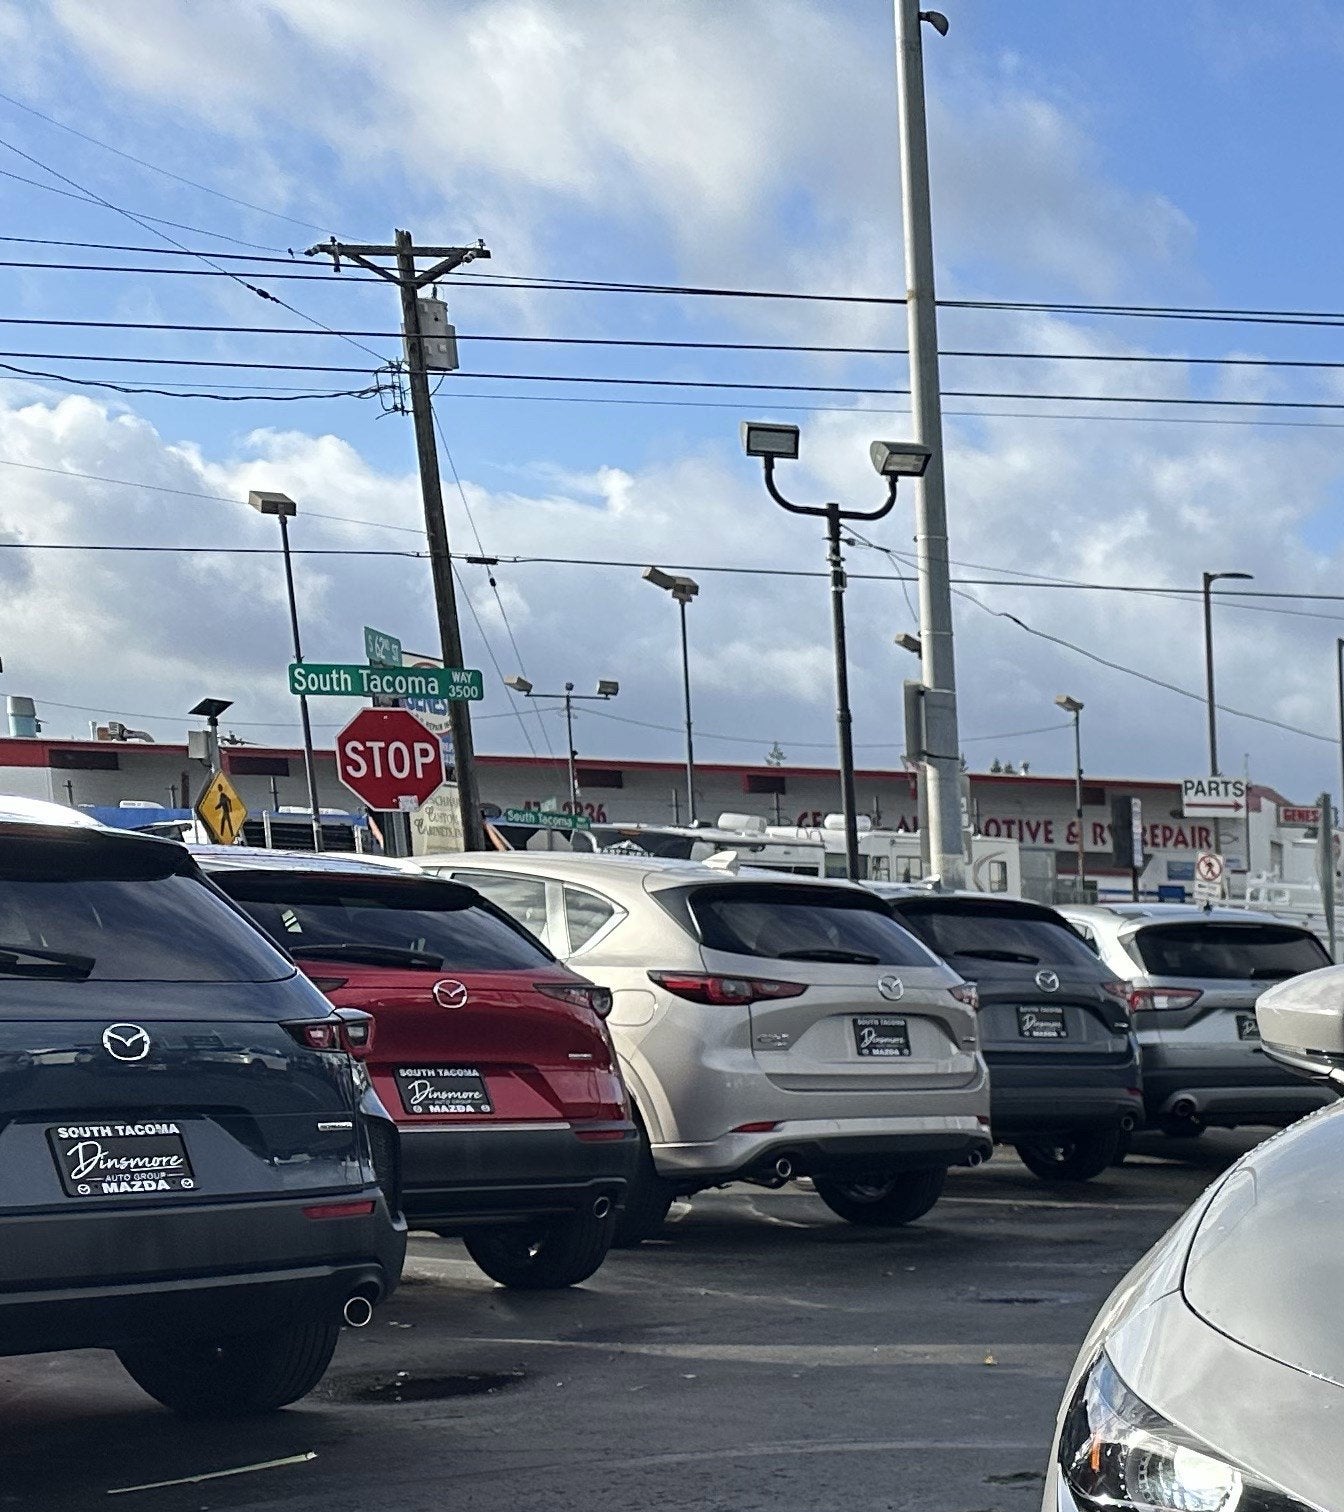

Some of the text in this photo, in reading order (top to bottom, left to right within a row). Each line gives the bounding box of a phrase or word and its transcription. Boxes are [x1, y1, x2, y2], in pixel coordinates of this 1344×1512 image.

[293, 667, 440, 696] South Tacoma
[451, 671, 473, 684] WAY
[448, 685, 479, 699] 3500
[344, 740, 436, 780] STOP
[1183, 779, 1245, 798] PARTS
[399, 1068, 480, 1077] SOUTH TACOMA
[407, 1079, 483, 1105] Dinsmore
[428, 1104, 475, 1113] MAZDA
[57, 1123, 180, 1139] SOUTH TACOMA
[66, 1140, 184, 1180] Dinsmore
[105, 1171, 167, 1183] AUTO GROUP
[101, 1179, 171, 1194] MAZDA
